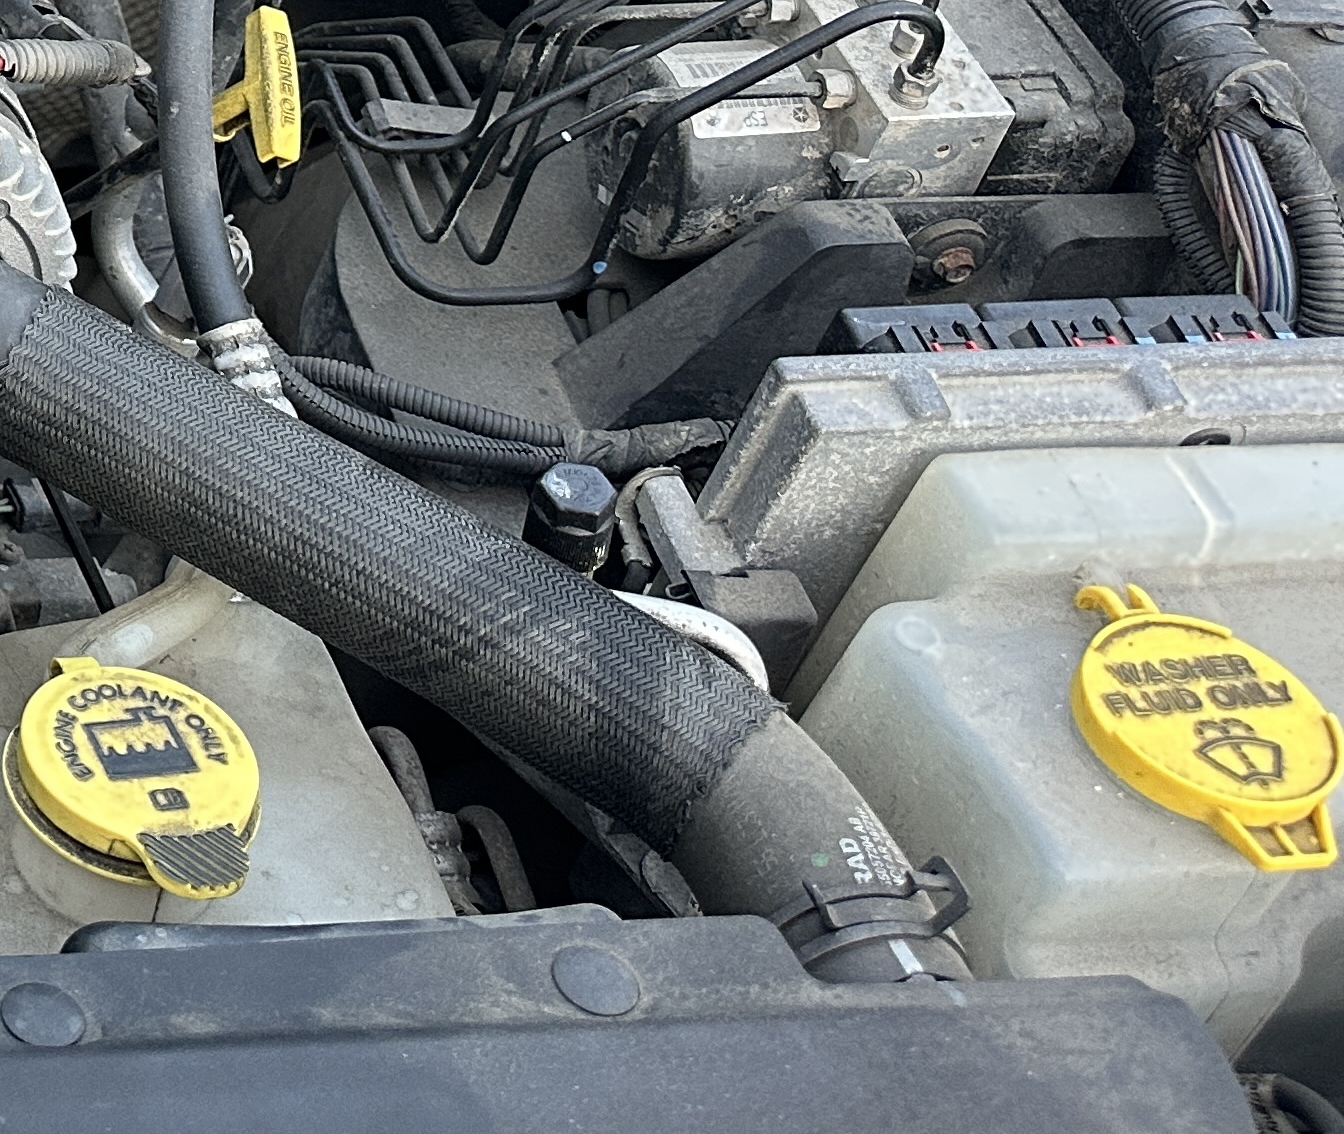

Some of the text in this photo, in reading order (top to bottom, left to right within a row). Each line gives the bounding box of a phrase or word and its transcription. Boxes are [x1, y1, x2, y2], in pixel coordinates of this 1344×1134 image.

[273, 31, 295, 128] ENGINE OIL
[742, 110, 767, 127] ESP
[1104, 653, 1257, 686] WASHER
[1101, 680, 1293, 717] FLUID ONLY
[52, 683, 229, 782] ENGINE COOLANT ONLY
